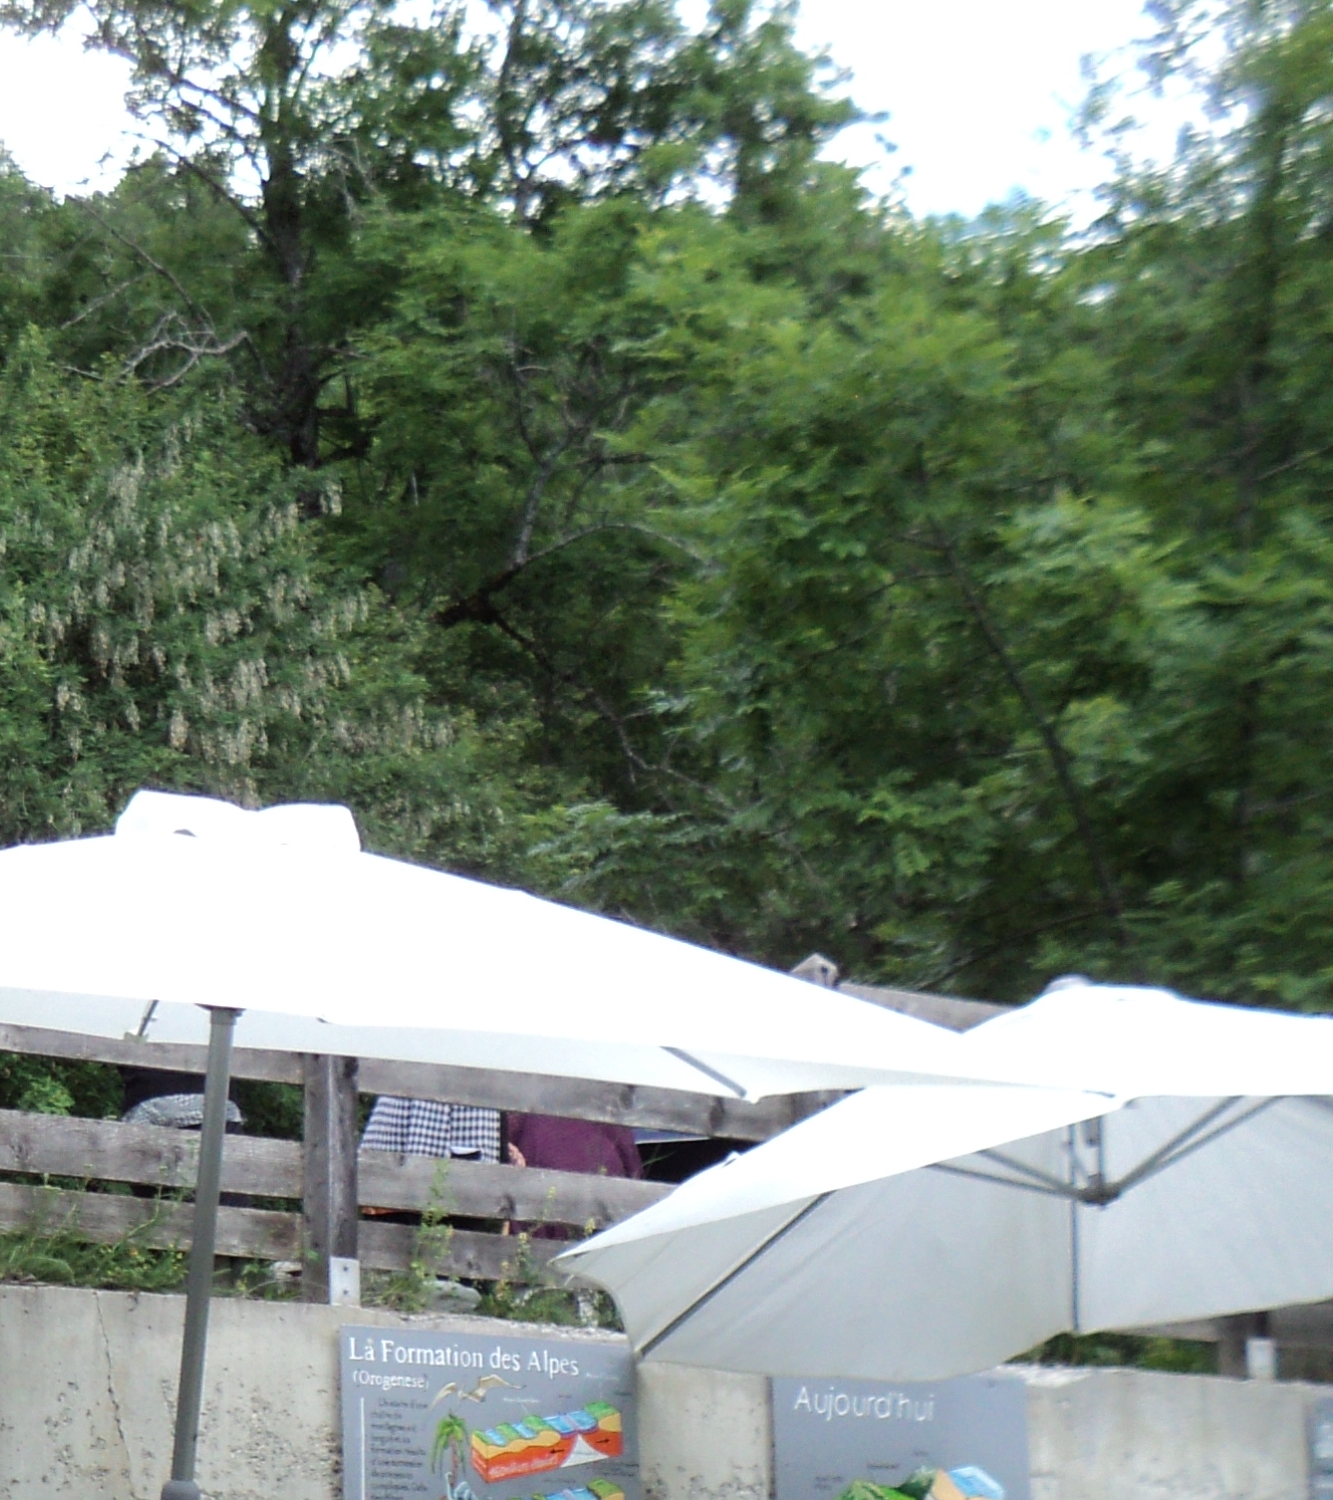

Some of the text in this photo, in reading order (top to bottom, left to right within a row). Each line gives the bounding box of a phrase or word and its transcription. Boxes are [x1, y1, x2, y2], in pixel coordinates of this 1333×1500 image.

[349, 1336, 580, 1380] La Formation des Alpes
[793, 1385, 935, 1422] Aujourd'hui
